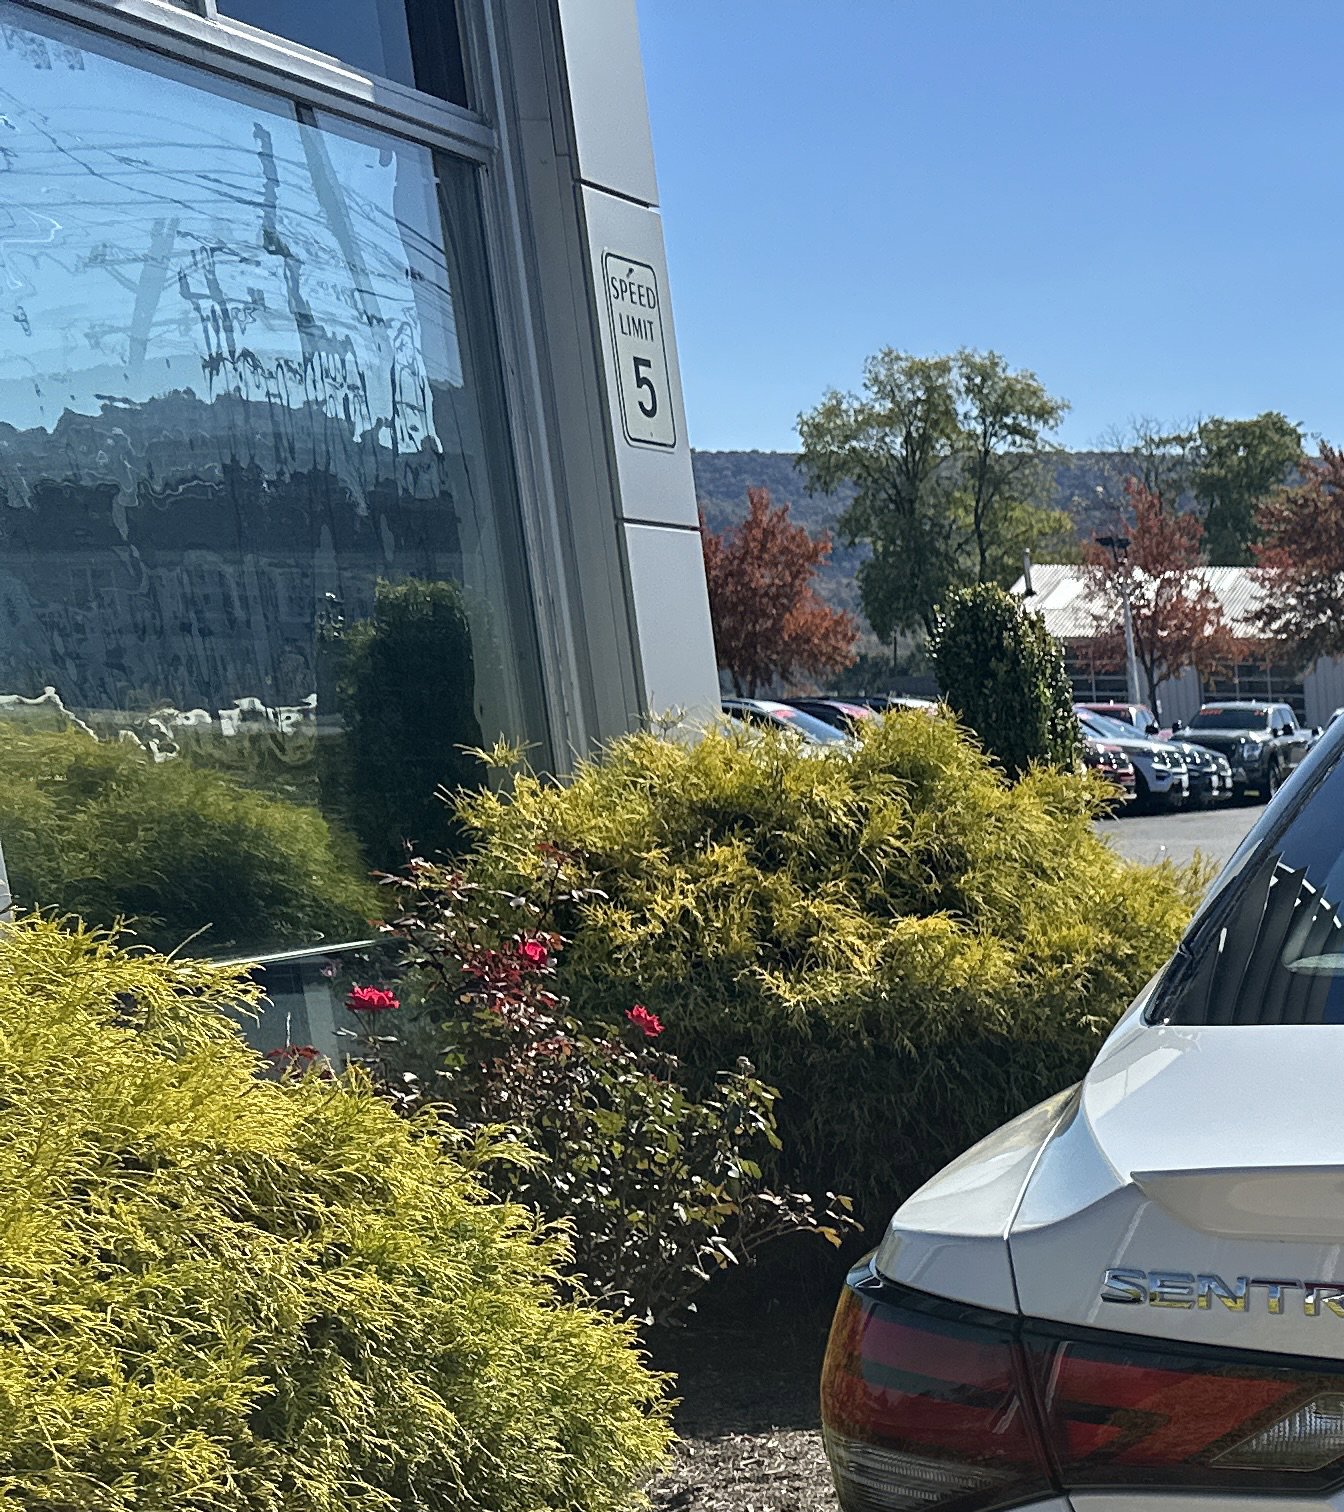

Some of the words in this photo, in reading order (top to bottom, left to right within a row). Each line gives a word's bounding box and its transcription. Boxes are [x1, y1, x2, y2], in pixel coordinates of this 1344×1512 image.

[610, 276, 657, 309] SPEED
[619, 312, 655, 342] LIMIT
[632, 356, 657, 418] 5
